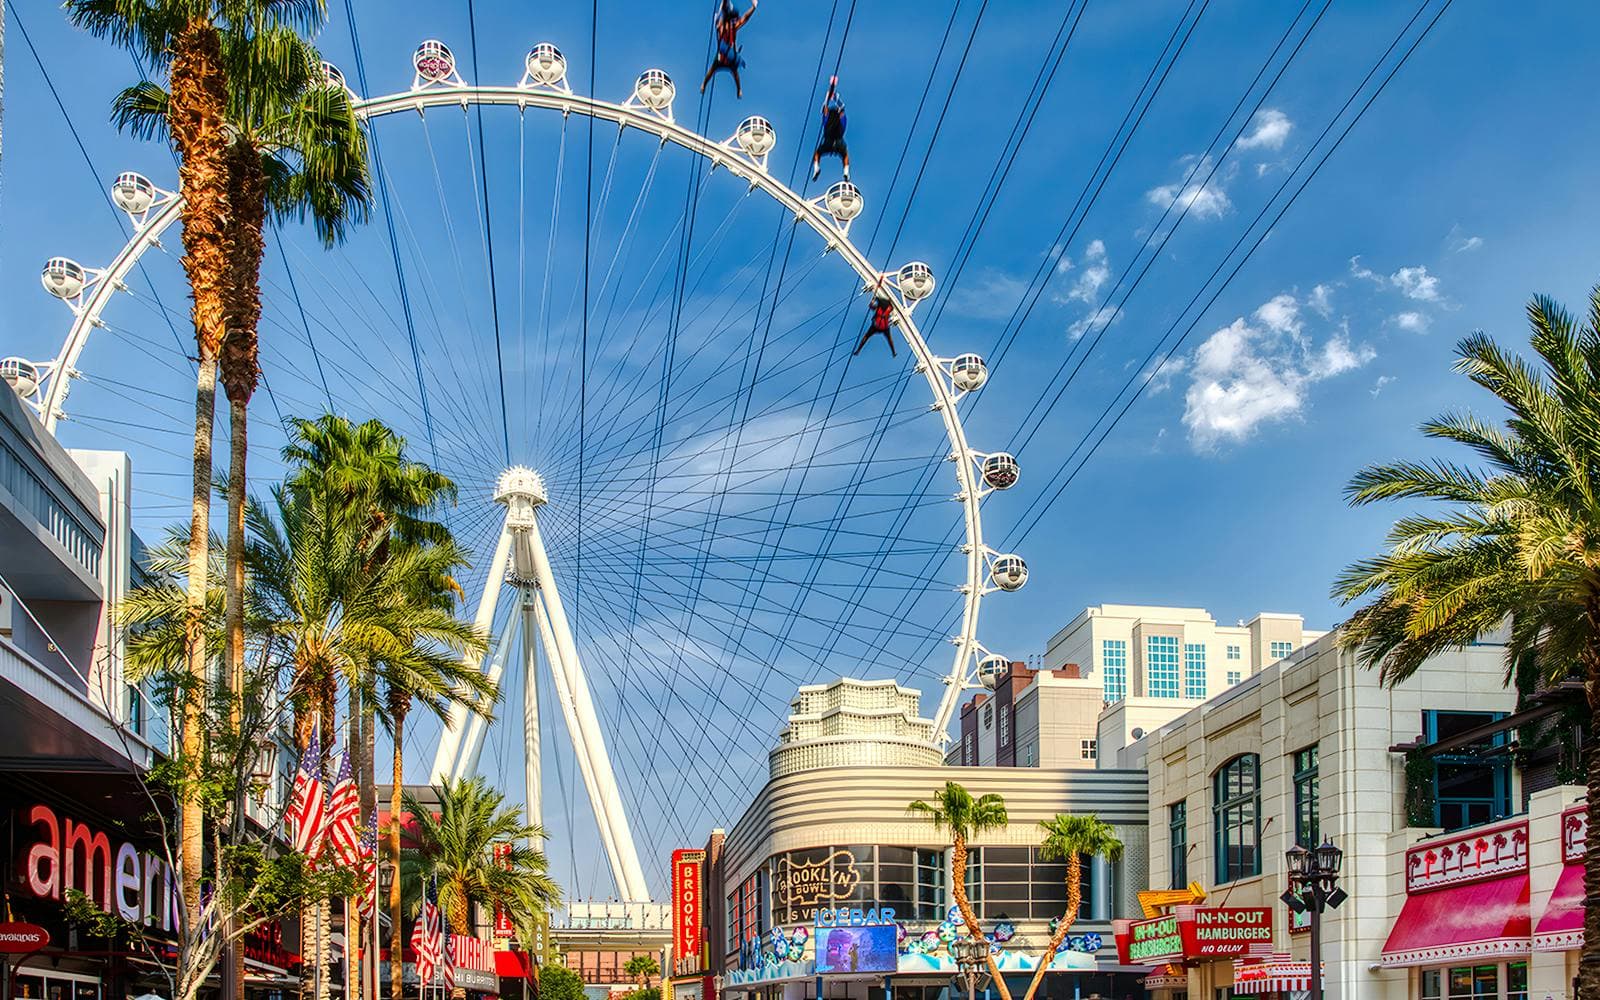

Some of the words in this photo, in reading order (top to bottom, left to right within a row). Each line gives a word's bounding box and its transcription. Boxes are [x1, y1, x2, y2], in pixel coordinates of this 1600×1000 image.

[28, 805, 214, 944] ameri
[795, 882, 828, 895] BOWL
[780, 910, 799, 923] LS
[814, 907, 896, 927] ICEBAR
[1196, 911, 1265, 924] IN-N-OUT
[536, 923, 544, 951] ARD
[1134, 918, 1177, 941] IN-N-OUT
[1196, 927, 1271, 940] HAMBURGERS
[1129, 934, 1183, 960] HAMBURGER
[1201, 945, 1214, 953] NO
[1216, 944, 1244, 953] DELAY
